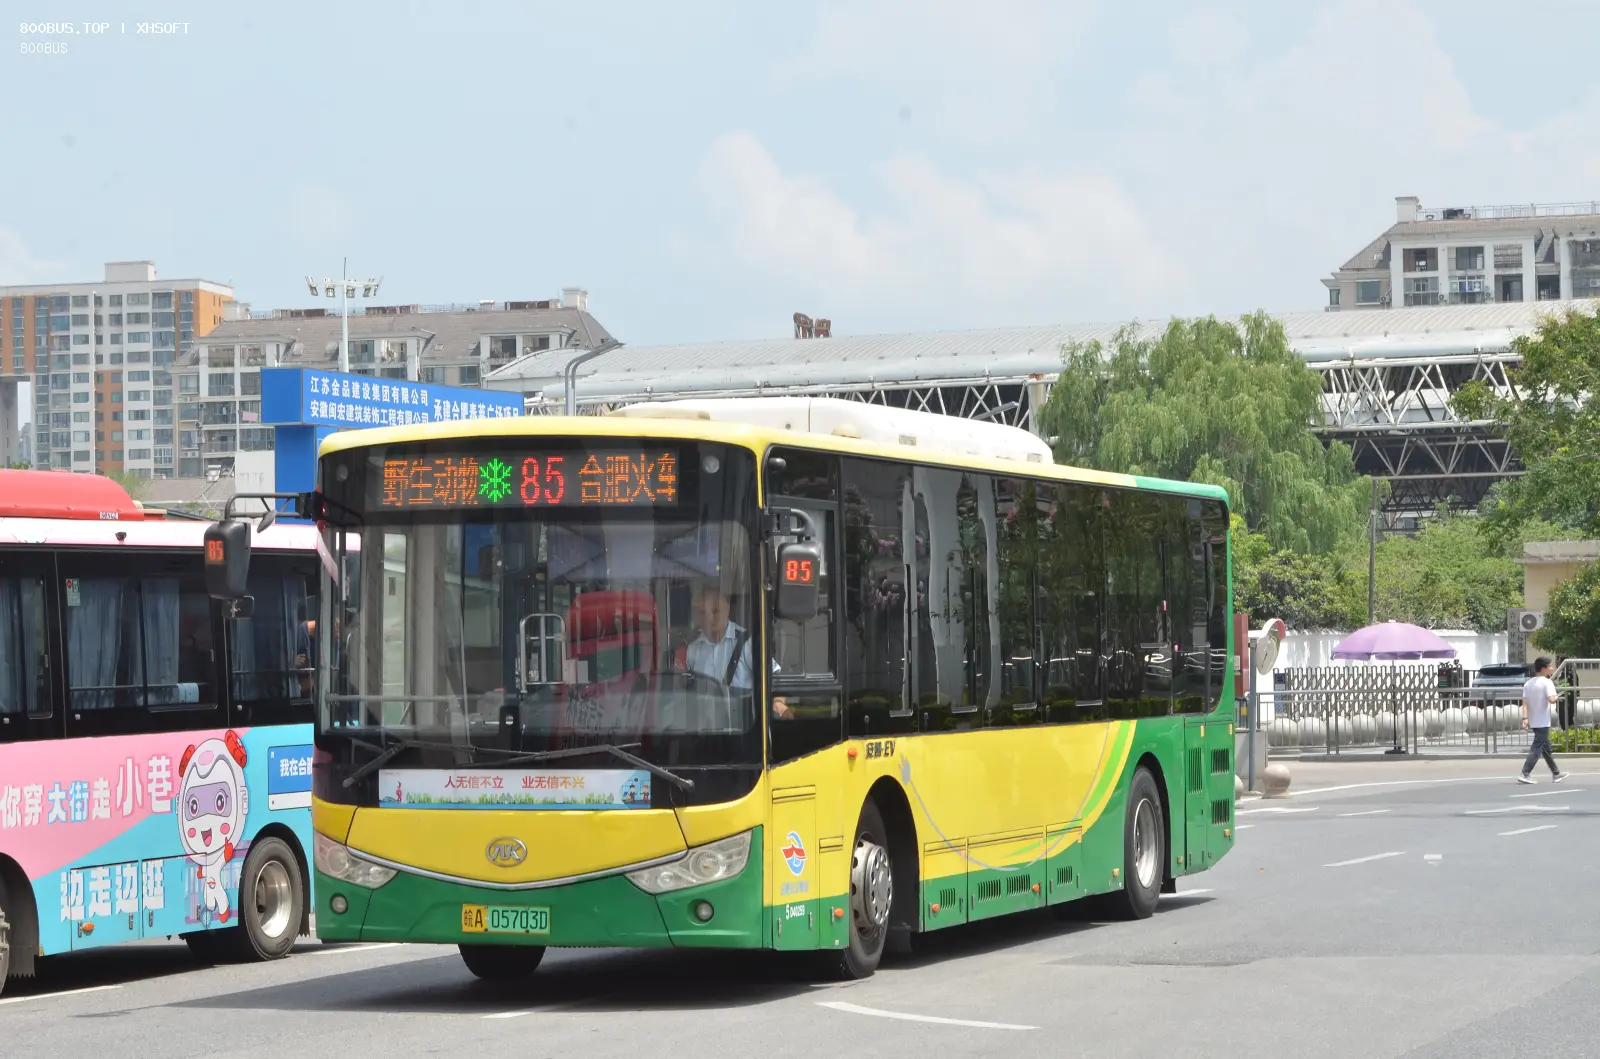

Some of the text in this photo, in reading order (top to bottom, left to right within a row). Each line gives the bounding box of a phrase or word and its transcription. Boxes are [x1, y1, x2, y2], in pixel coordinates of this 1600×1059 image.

[383, 453, 676, 506] 野生动物 85 合肥火车
[208, 540, 224, 560] 85
[786, 560, 811, 581] 85
[0, 755, 173, 829] 你穿大街走小巷
[444, 775, 585, 789] 人无信不立 业无信不兴
[60, 858, 166, 923] 边走边逛
[491, 909, 548, 929] 05703D
